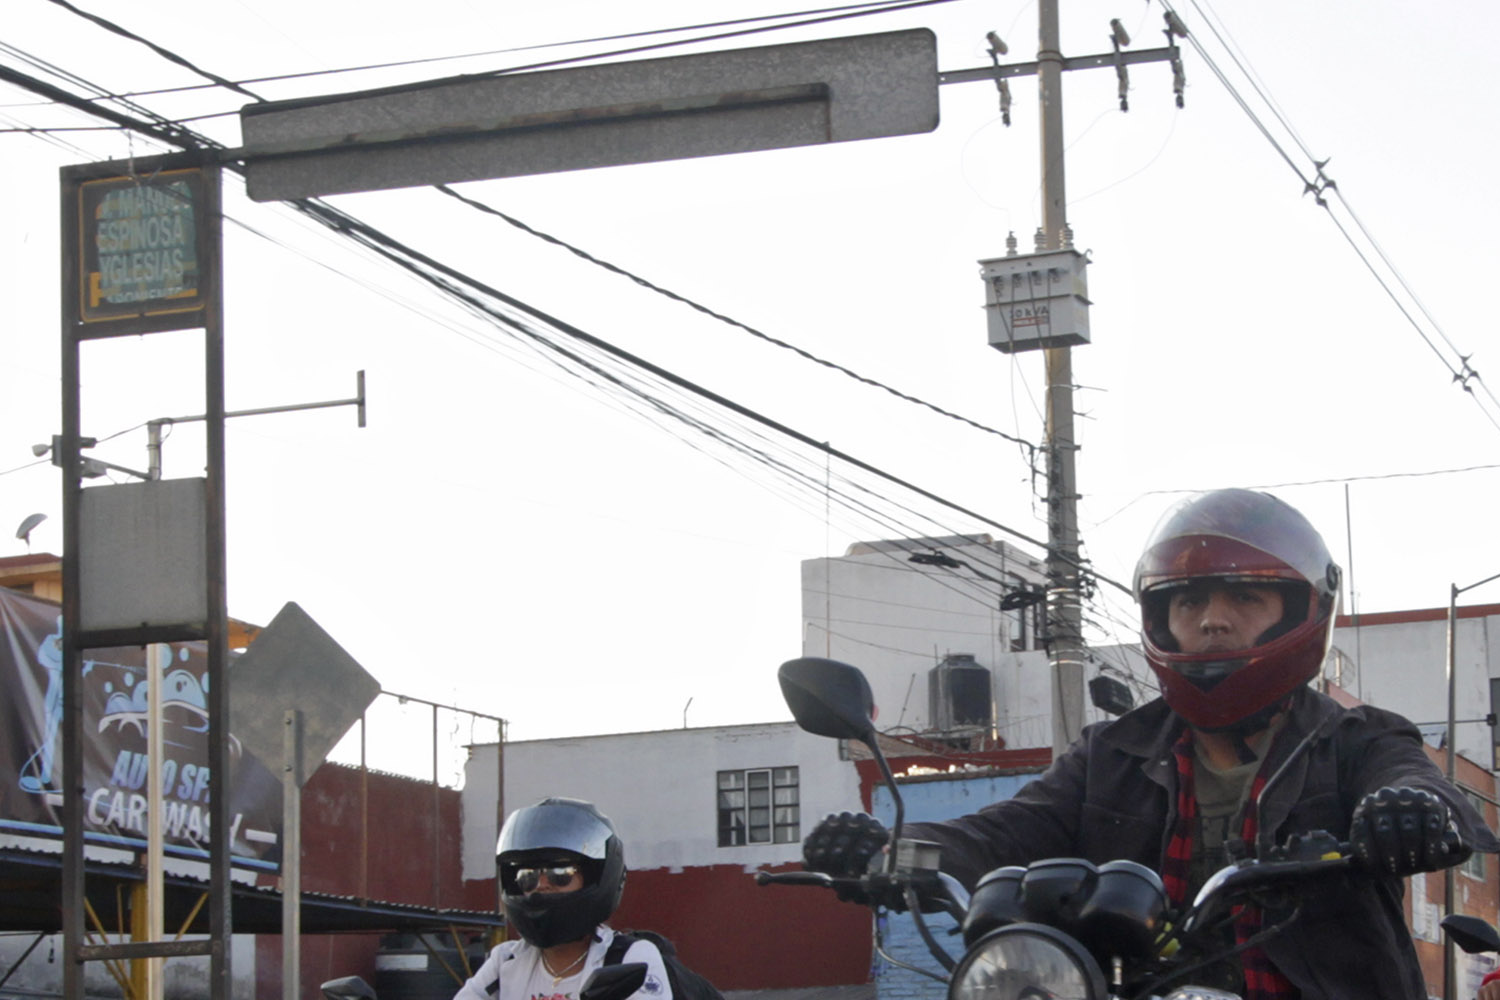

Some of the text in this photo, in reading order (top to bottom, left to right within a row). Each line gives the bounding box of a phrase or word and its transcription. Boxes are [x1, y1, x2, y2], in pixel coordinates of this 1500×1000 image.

[98, 216, 184, 253] ESPINOSA
[99, 248, 184, 287] YGLESIAS
[111, 750, 210, 803] AUO SP
[88, 788, 147, 832] CAR
